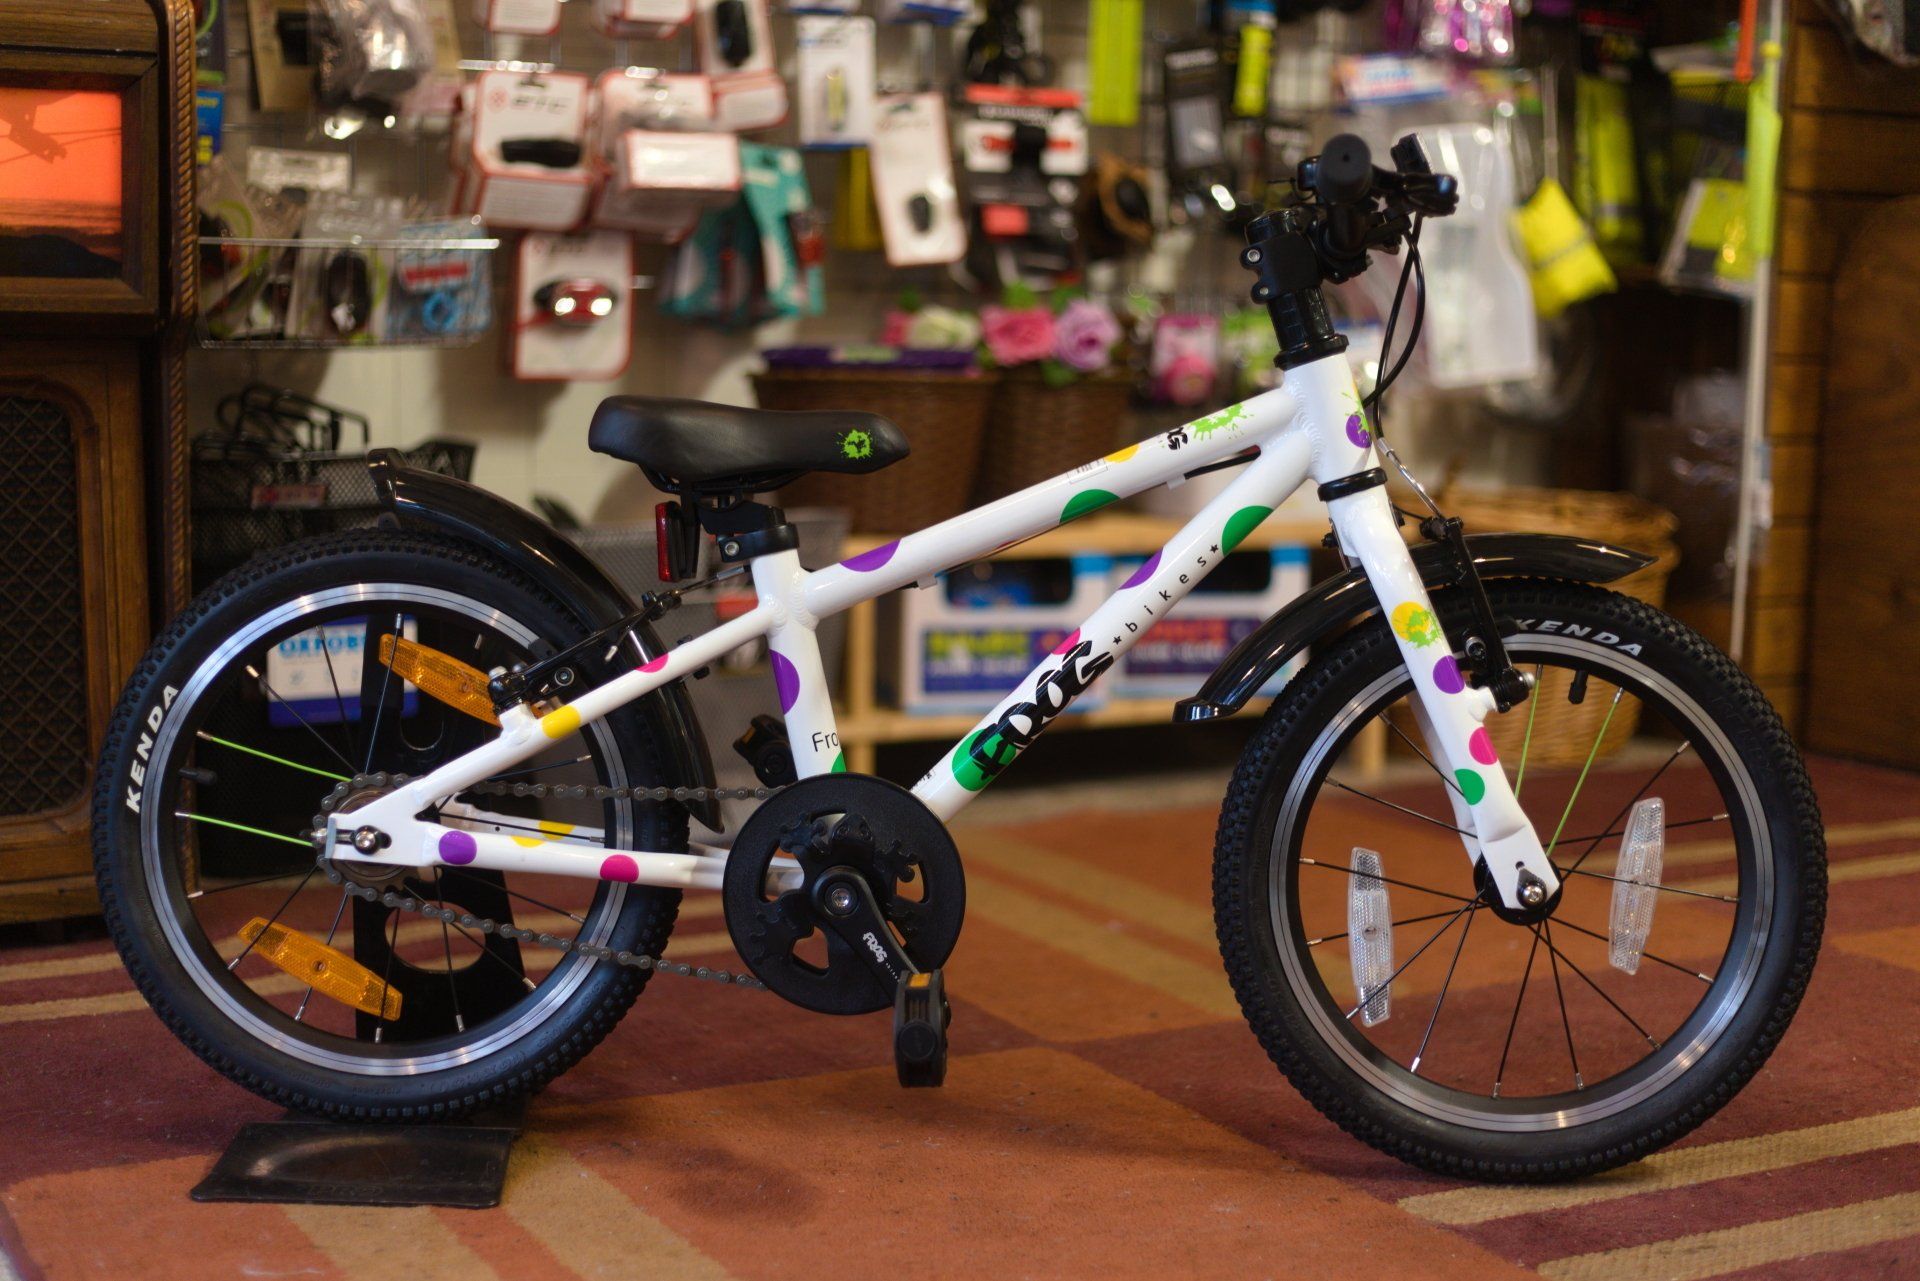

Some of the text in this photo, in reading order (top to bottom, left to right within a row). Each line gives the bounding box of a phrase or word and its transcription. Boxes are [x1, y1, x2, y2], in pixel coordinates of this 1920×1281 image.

[1125, 556, 1208, 633] bikes
[279, 633, 367, 658] OXFOR
[1516, 618, 1643, 657] KENDA
[126, 685, 179, 814] KENDA
